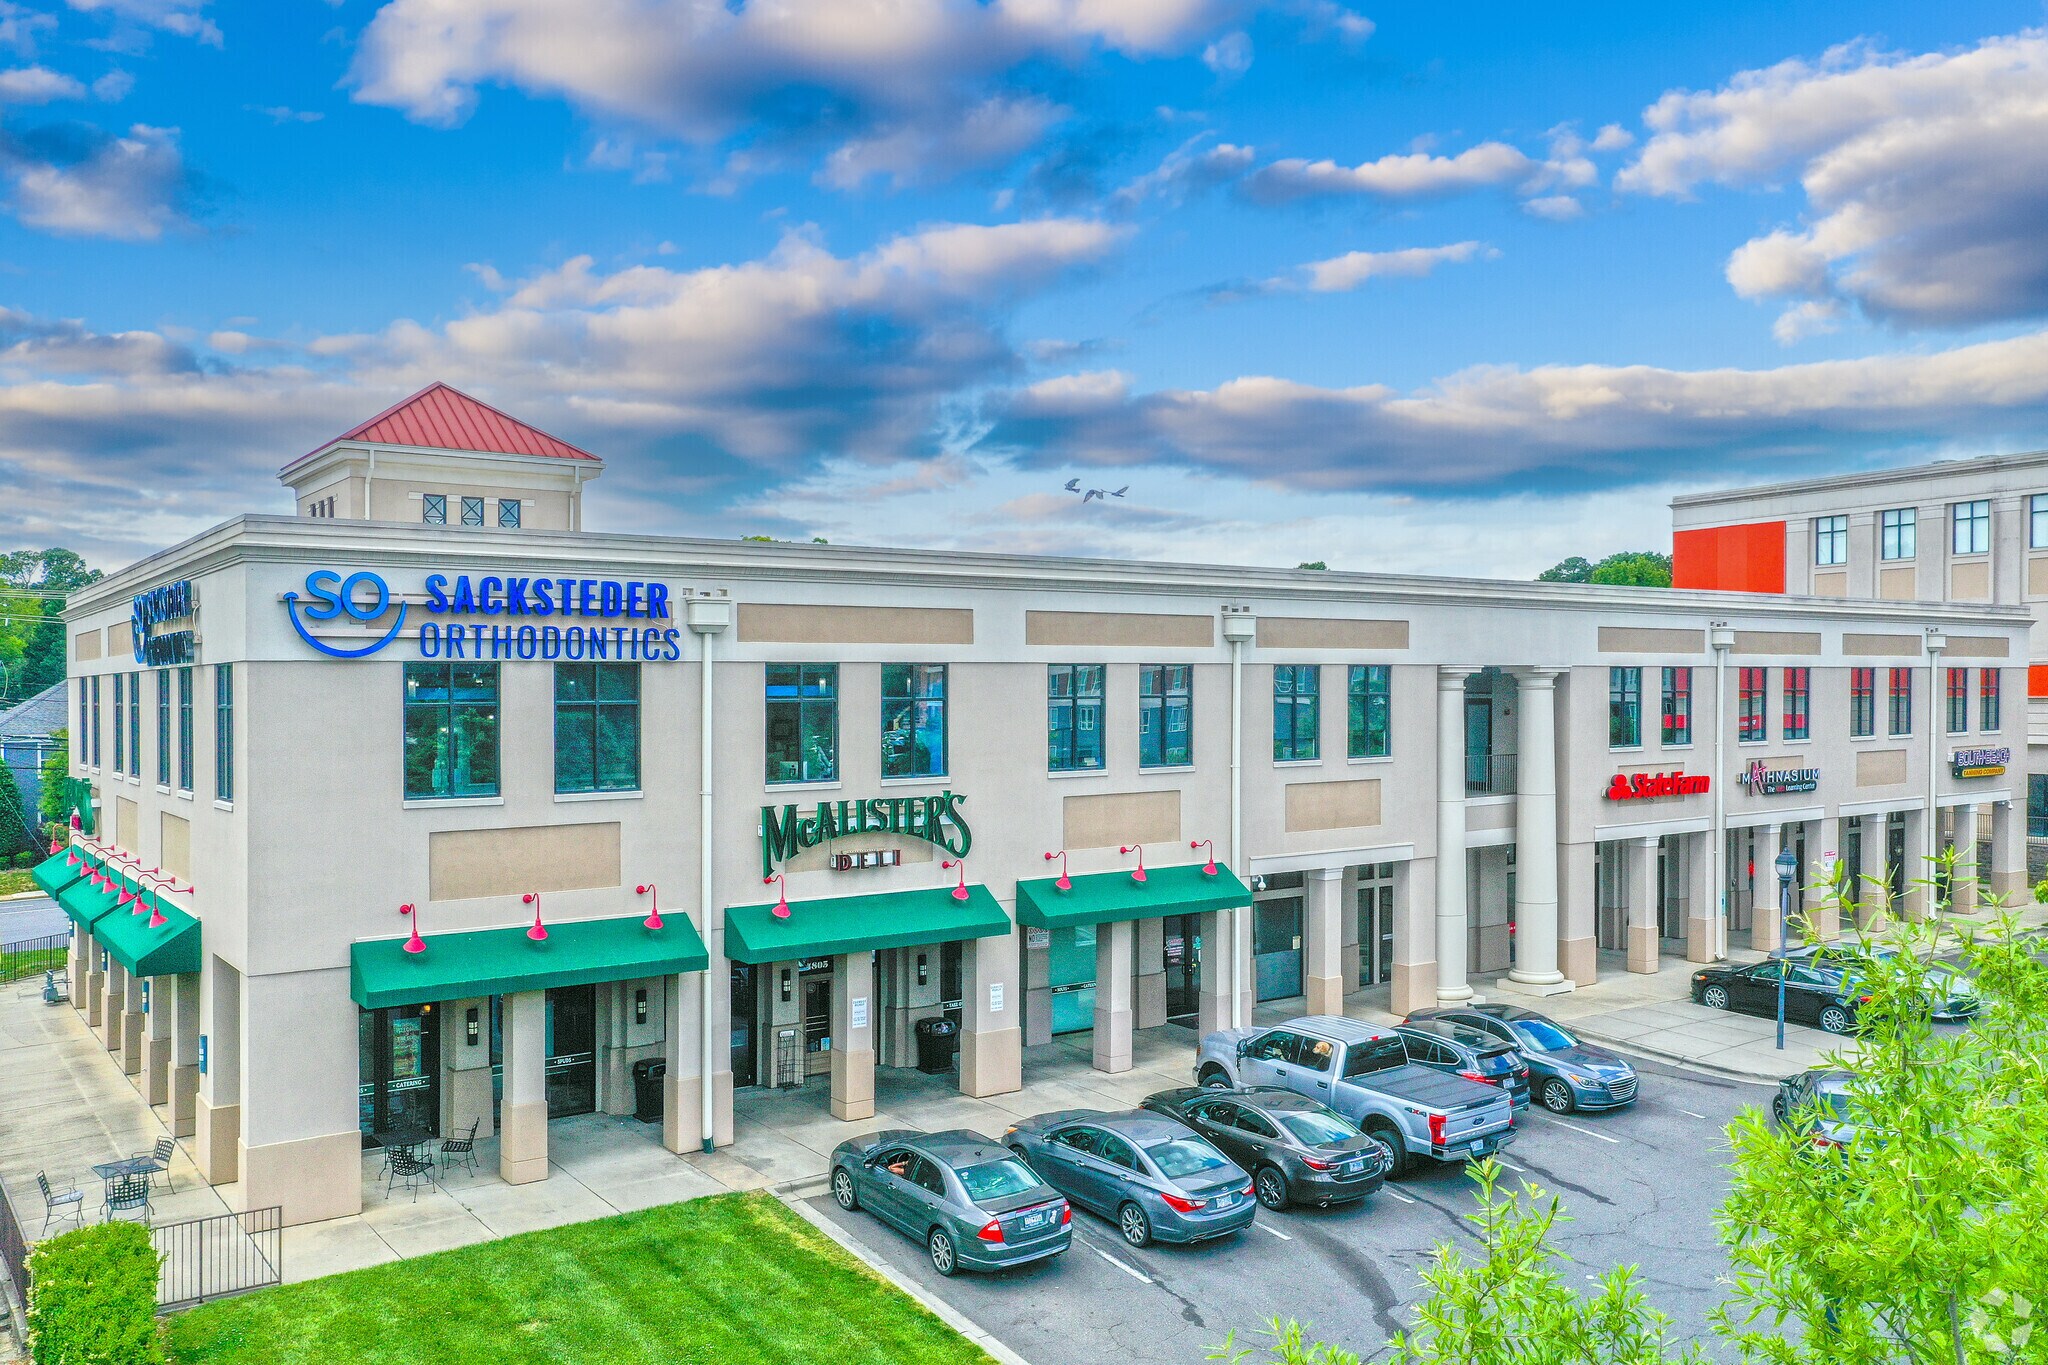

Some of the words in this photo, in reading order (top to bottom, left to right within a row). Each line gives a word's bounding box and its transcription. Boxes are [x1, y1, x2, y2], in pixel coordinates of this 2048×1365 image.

[305, 570, 390, 620] SO
[425, 573, 670, 619] SACKSTEDER
[419, 622, 681, 661] ORTHODONTICS
[1957, 750, 1984, 766] SOUTH
[1984, 747, 2010, 764] BEACH
[836, 849, 901, 873] DELI
[395, 1080, 422, 1089] CATERING
